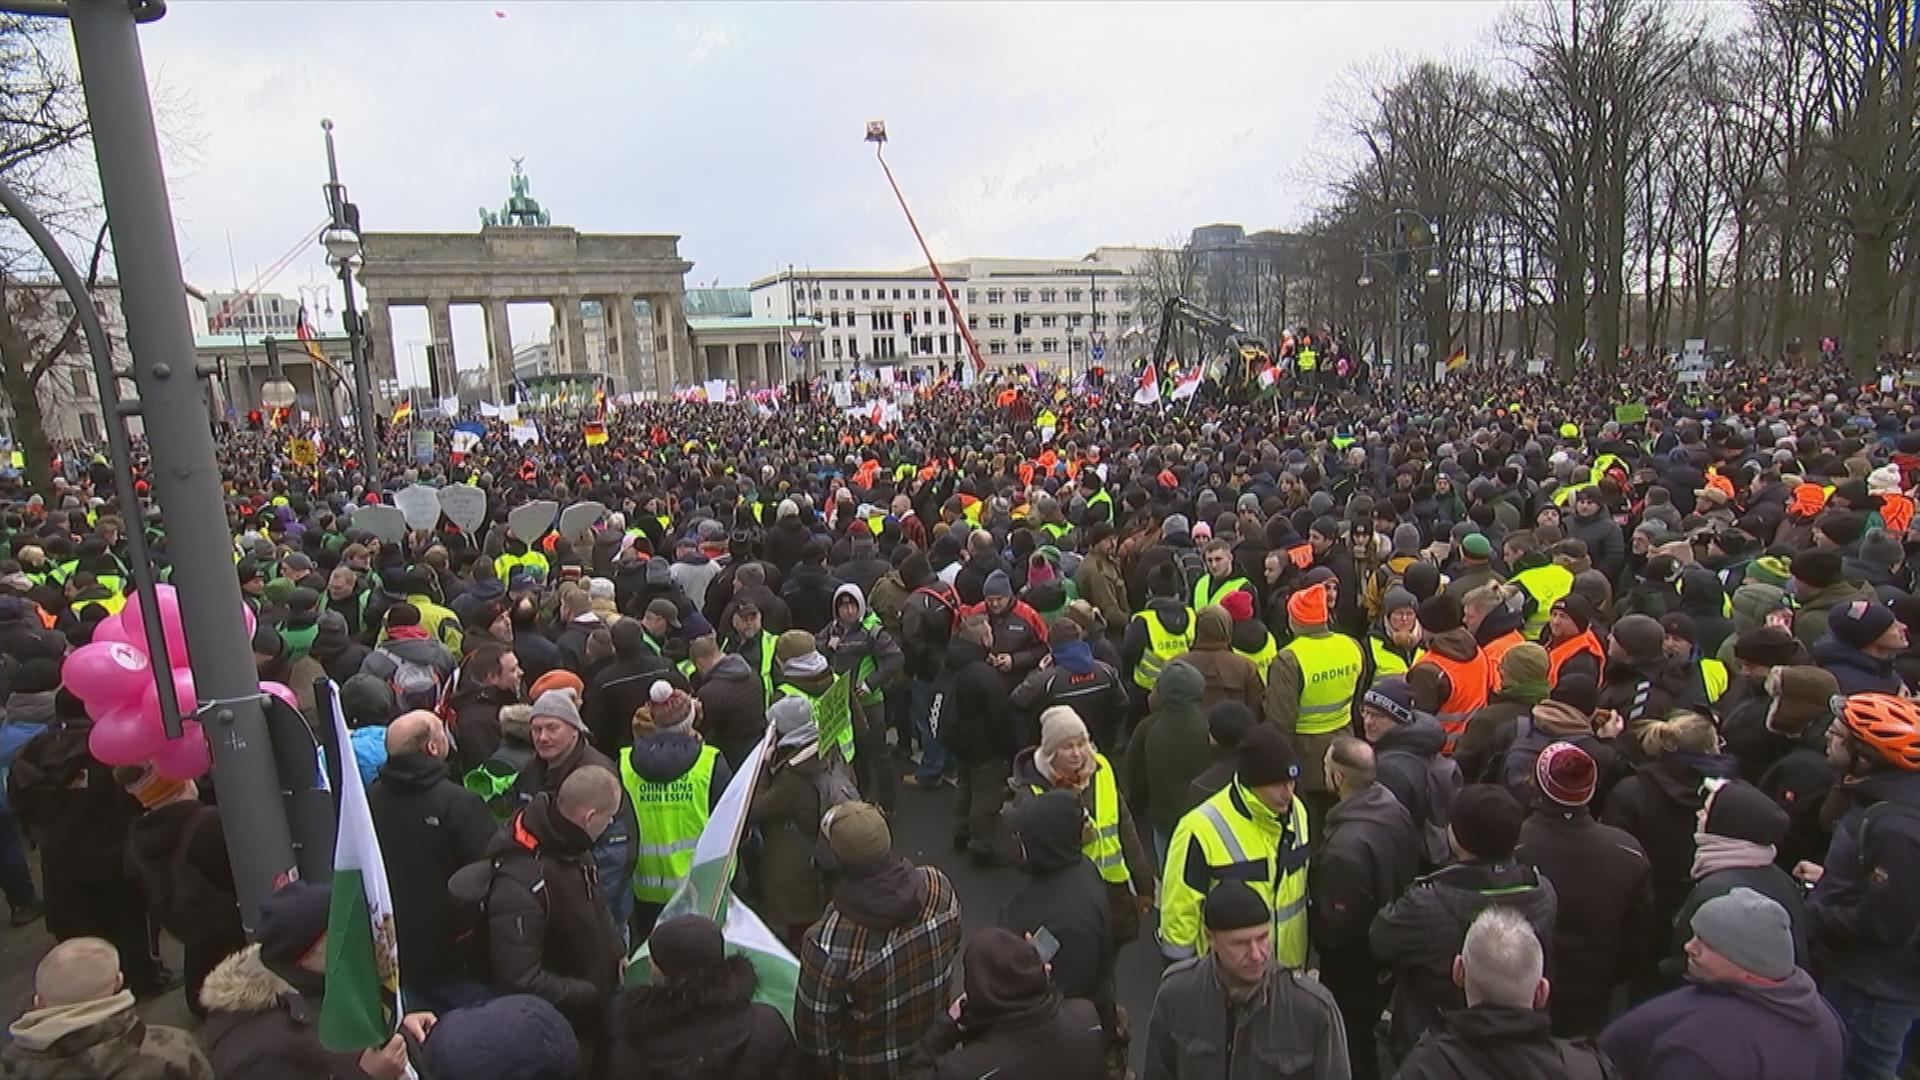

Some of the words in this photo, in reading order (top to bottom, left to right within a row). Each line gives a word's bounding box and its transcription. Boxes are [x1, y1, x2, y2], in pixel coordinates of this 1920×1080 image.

[1157, 640, 1185, 650] ORDN
[1312, 663, 1359, 684] ORDNER
[639, 782, 668, 793] OHNE
[671, 782, 694, 792] UNS
[639, 792, 662, 803] KEIN
[664, 792, 694, 802] ESSEN
